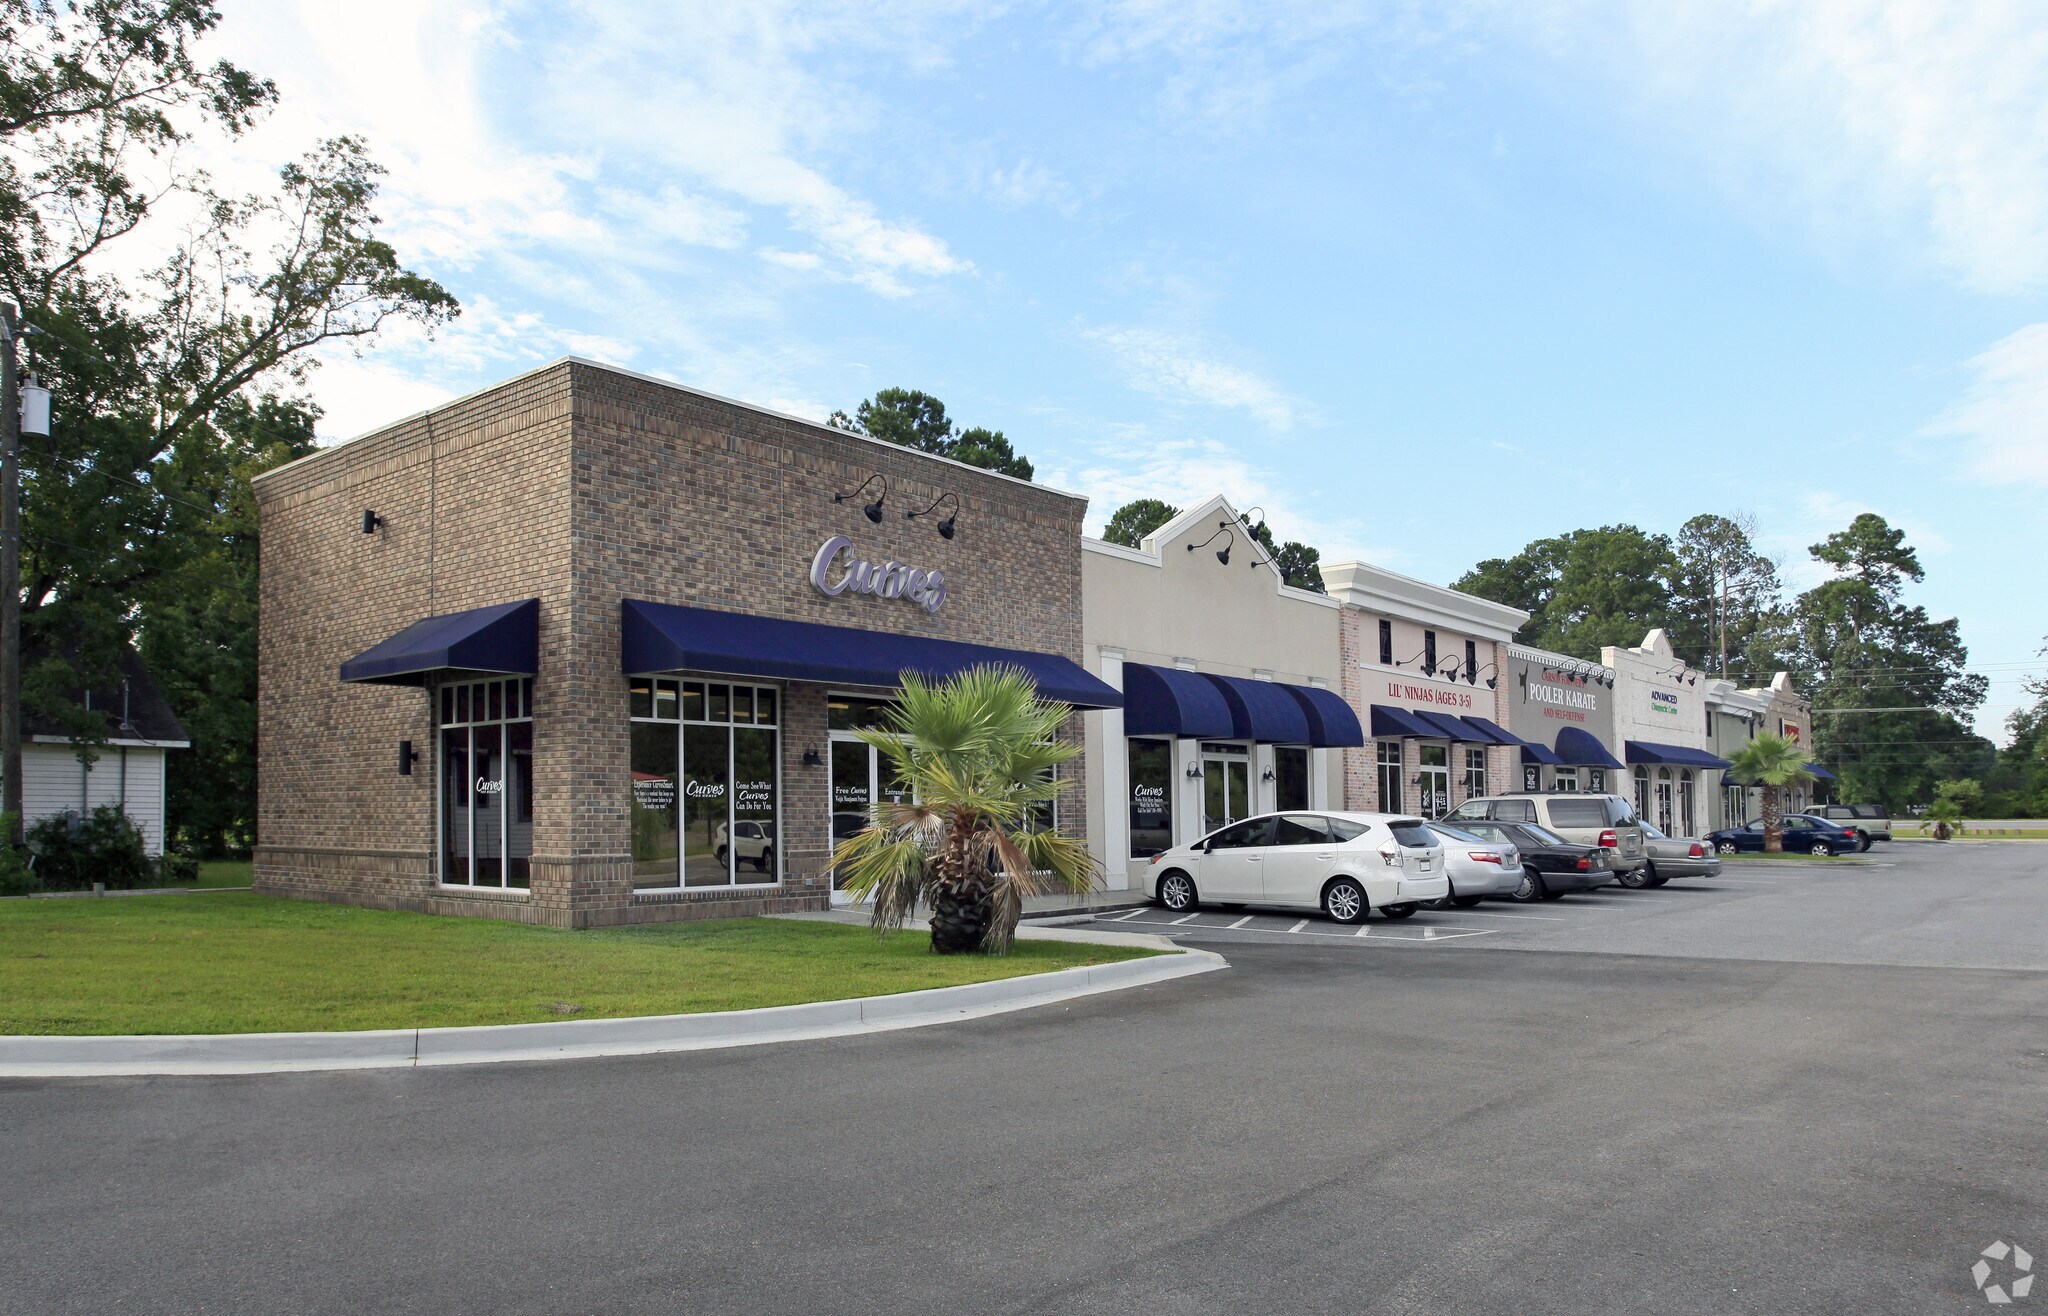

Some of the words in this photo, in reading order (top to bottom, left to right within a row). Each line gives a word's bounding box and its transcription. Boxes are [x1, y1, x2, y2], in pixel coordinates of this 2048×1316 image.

[810, 535, 946, 613] Curves
[1388, 683, 1402, 698] LIL'
[1404, 685, 1433, 703] NINJAS
[1435, 689, 1457, 706] (AGES
[1459, 694, 1472, 709] 3-5)
[1529, 683, 1564, 705] POOLER
[1566, 689, 1597, 711] KARATE
[1651, 690, 1678, 705] ADVANCED
[1544, 707, 1554, 717] AND
[1555, 709, 1586, 722] SELF-DEFENSE
[476, 776, 503, 792] Curves
[686, 780, 725, 796] Curves
[735, 781, 750, 790] Come
[835, 786, 849, 794] Free
[1135, 784, 1163, 796] Curves
[739, 790, 769, 800] Curves
[735, 801, 746, 810] Can
[746, 802, 753, 810] Do
[753, 802, 761, 810] For
[762, 802, 772, 810] You
